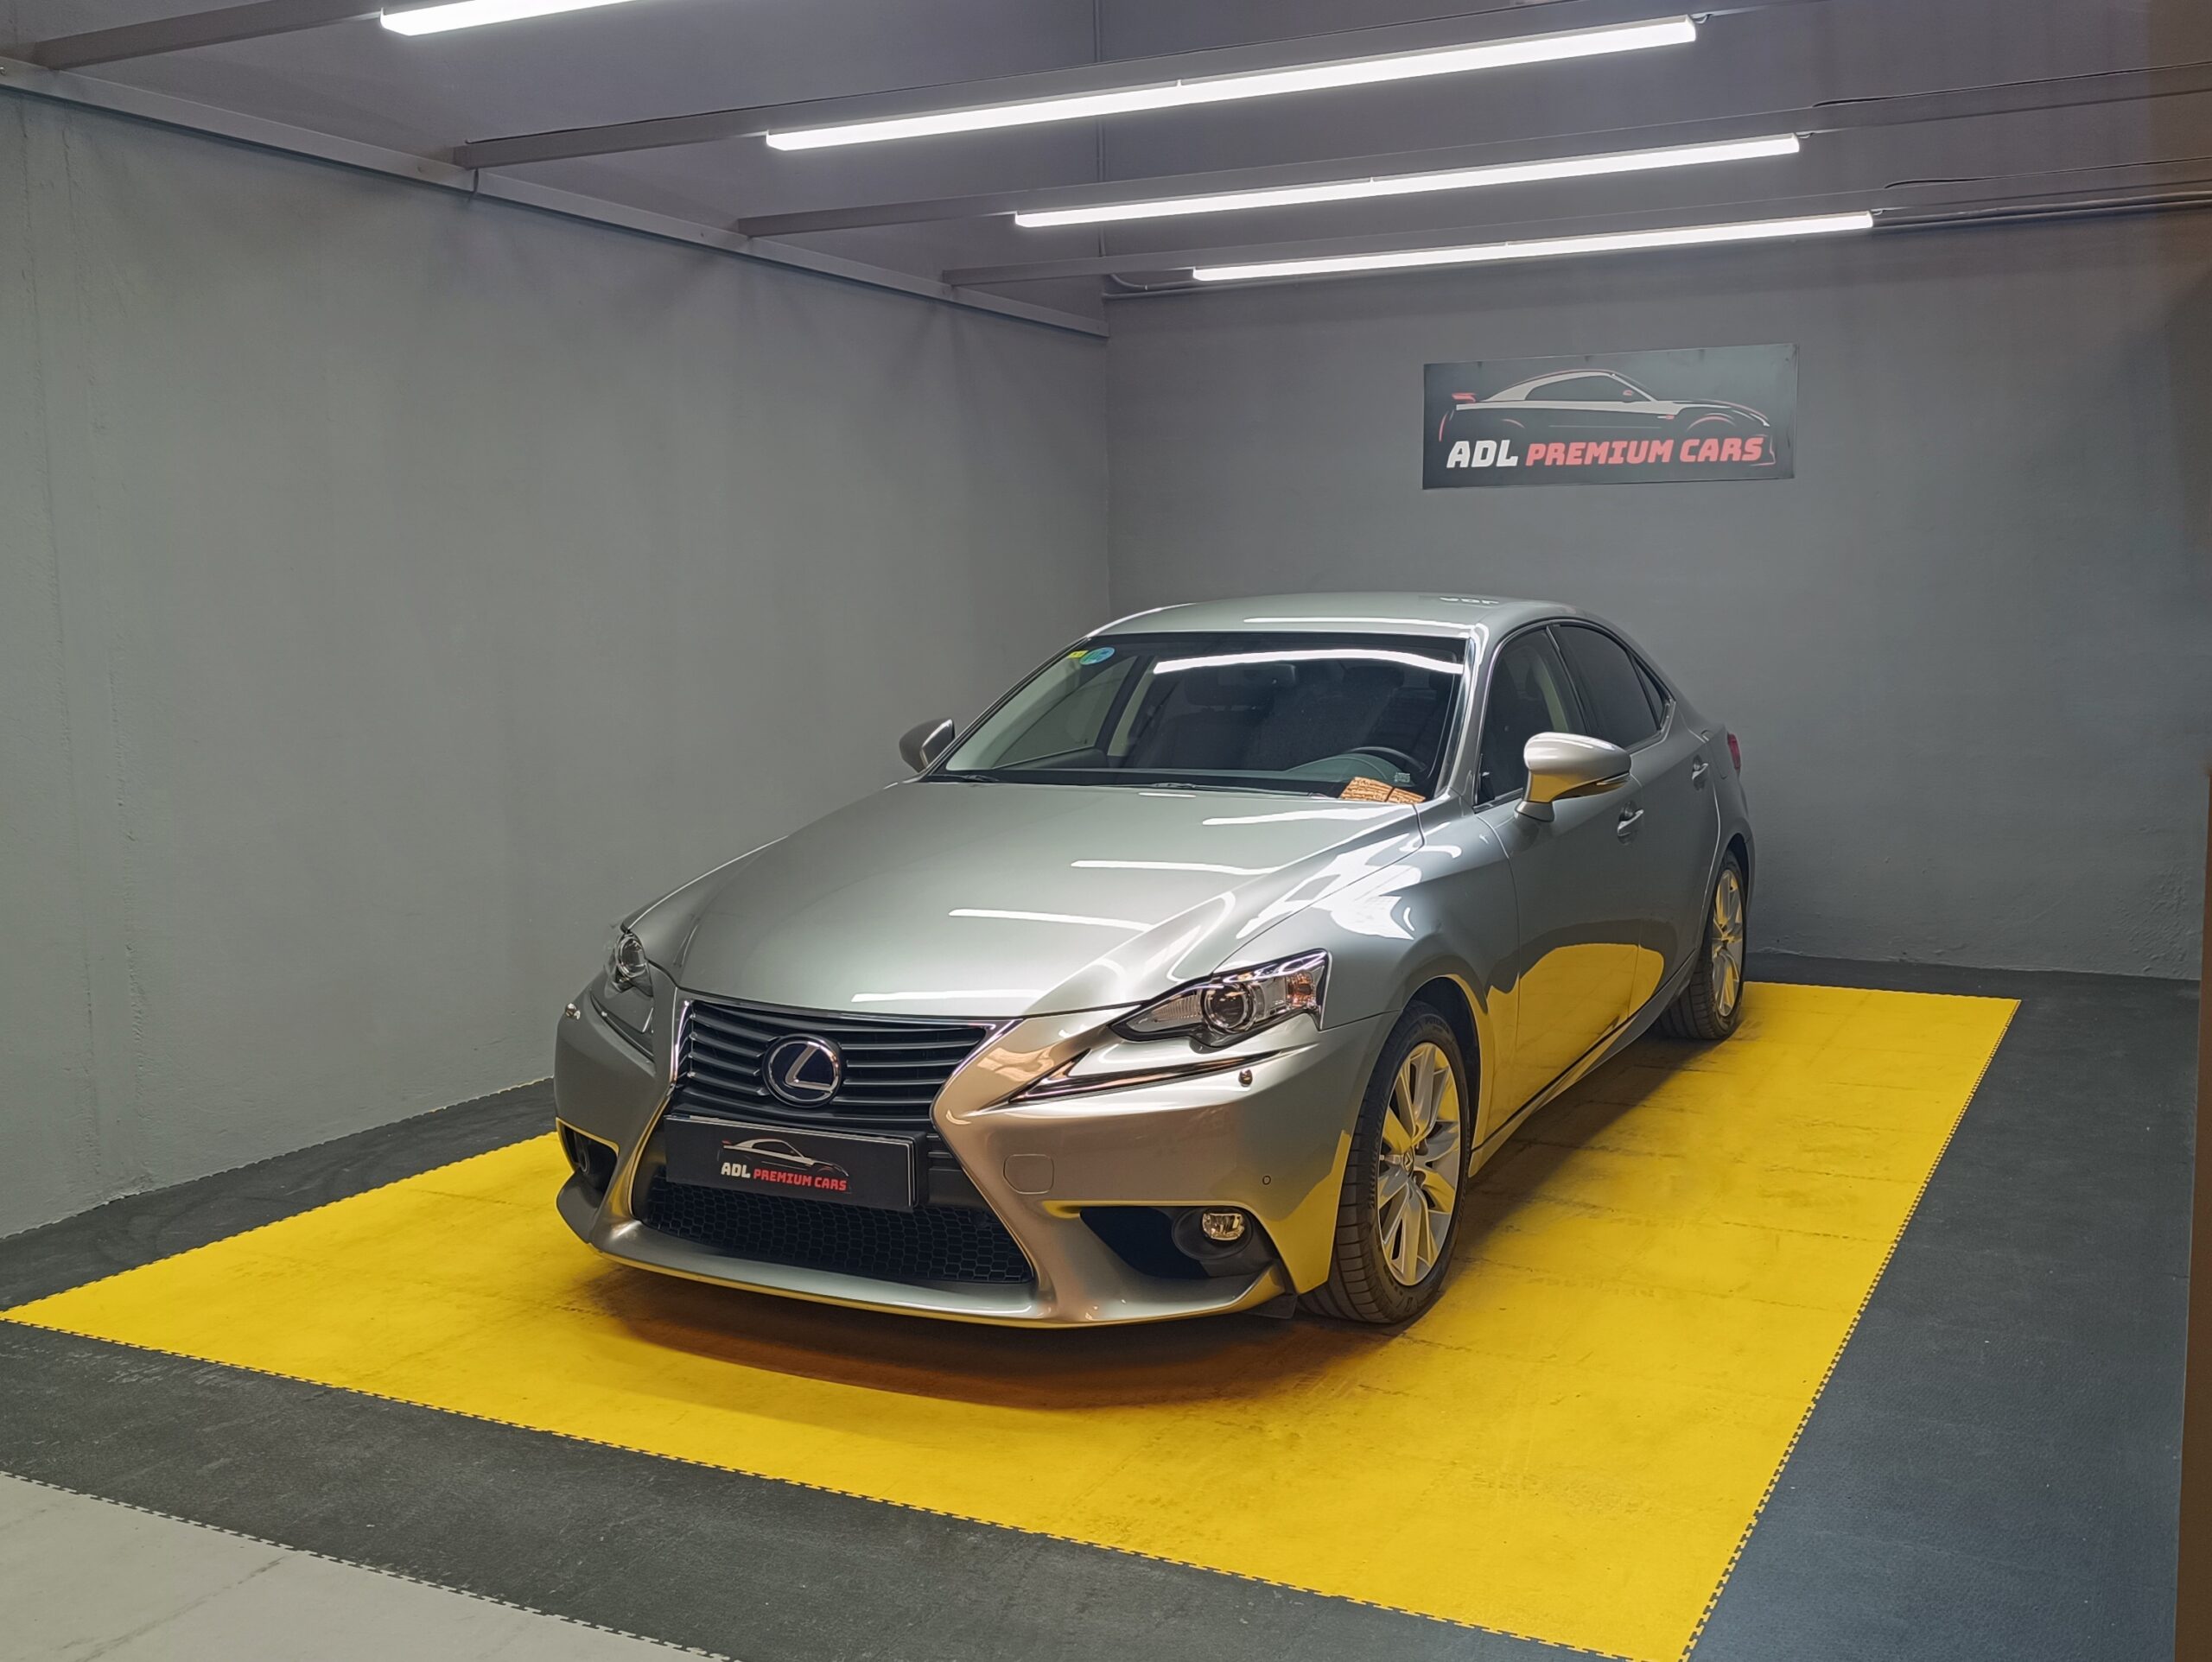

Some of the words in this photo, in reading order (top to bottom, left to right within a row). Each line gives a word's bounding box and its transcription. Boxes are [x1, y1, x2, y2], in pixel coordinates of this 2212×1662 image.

[1446, 439, 1519, 468] ADL
[1525, 439, 1675, 466] PREMIUM
[1679, 437, 1764, 463] CARS
[721, 1162, 751, 1179] ADL
[753, 1169, 812, 1187] PREMIUM
[814, 1177, 848, 1191] CARS
